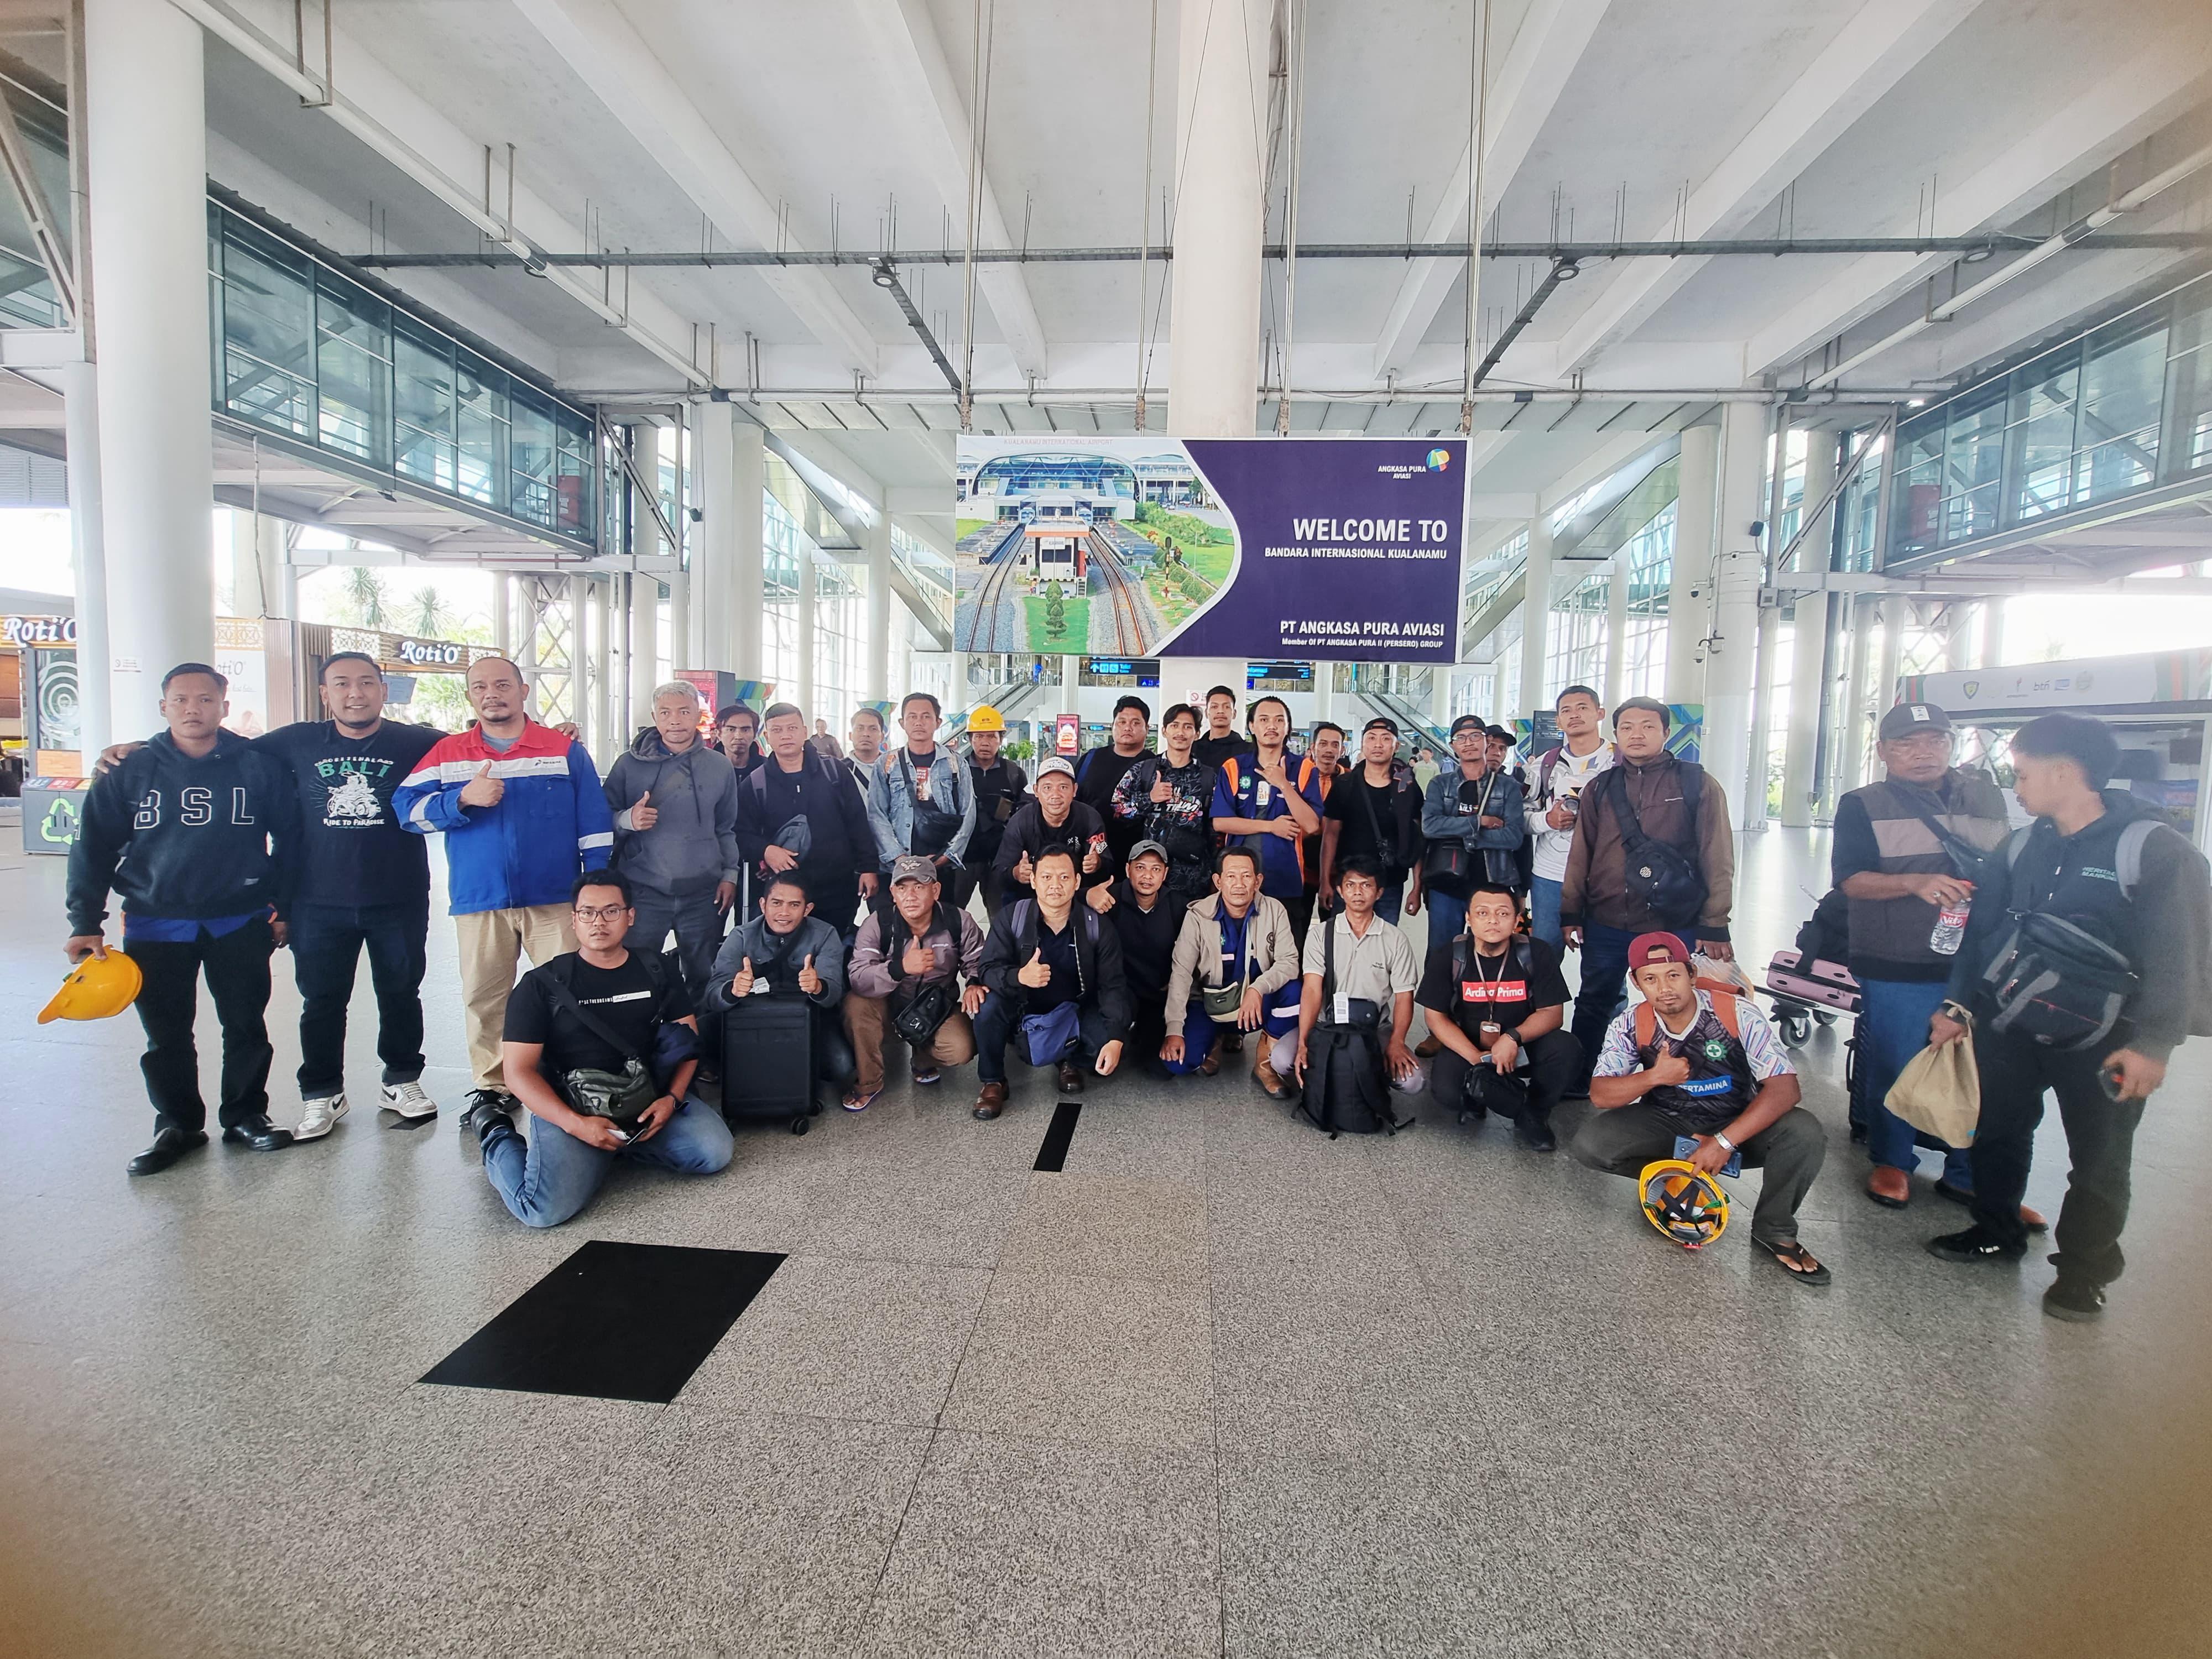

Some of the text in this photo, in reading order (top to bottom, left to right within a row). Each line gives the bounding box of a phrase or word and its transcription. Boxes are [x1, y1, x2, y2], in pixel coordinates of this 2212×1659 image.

[1293, 518, 1448, 542] WELCOME TO
[1265, 547, 1447, 559] BANDARA INTERNASIONAL KUALANAMU
[1280, 621, 1444, 636] PT ANGKASA PURA AVIASI
[1384, 640, 1418, 649] (PERSERO)
[317, 761, 392, 778] BALI
[1497, 987, 1524, 997] Prima
